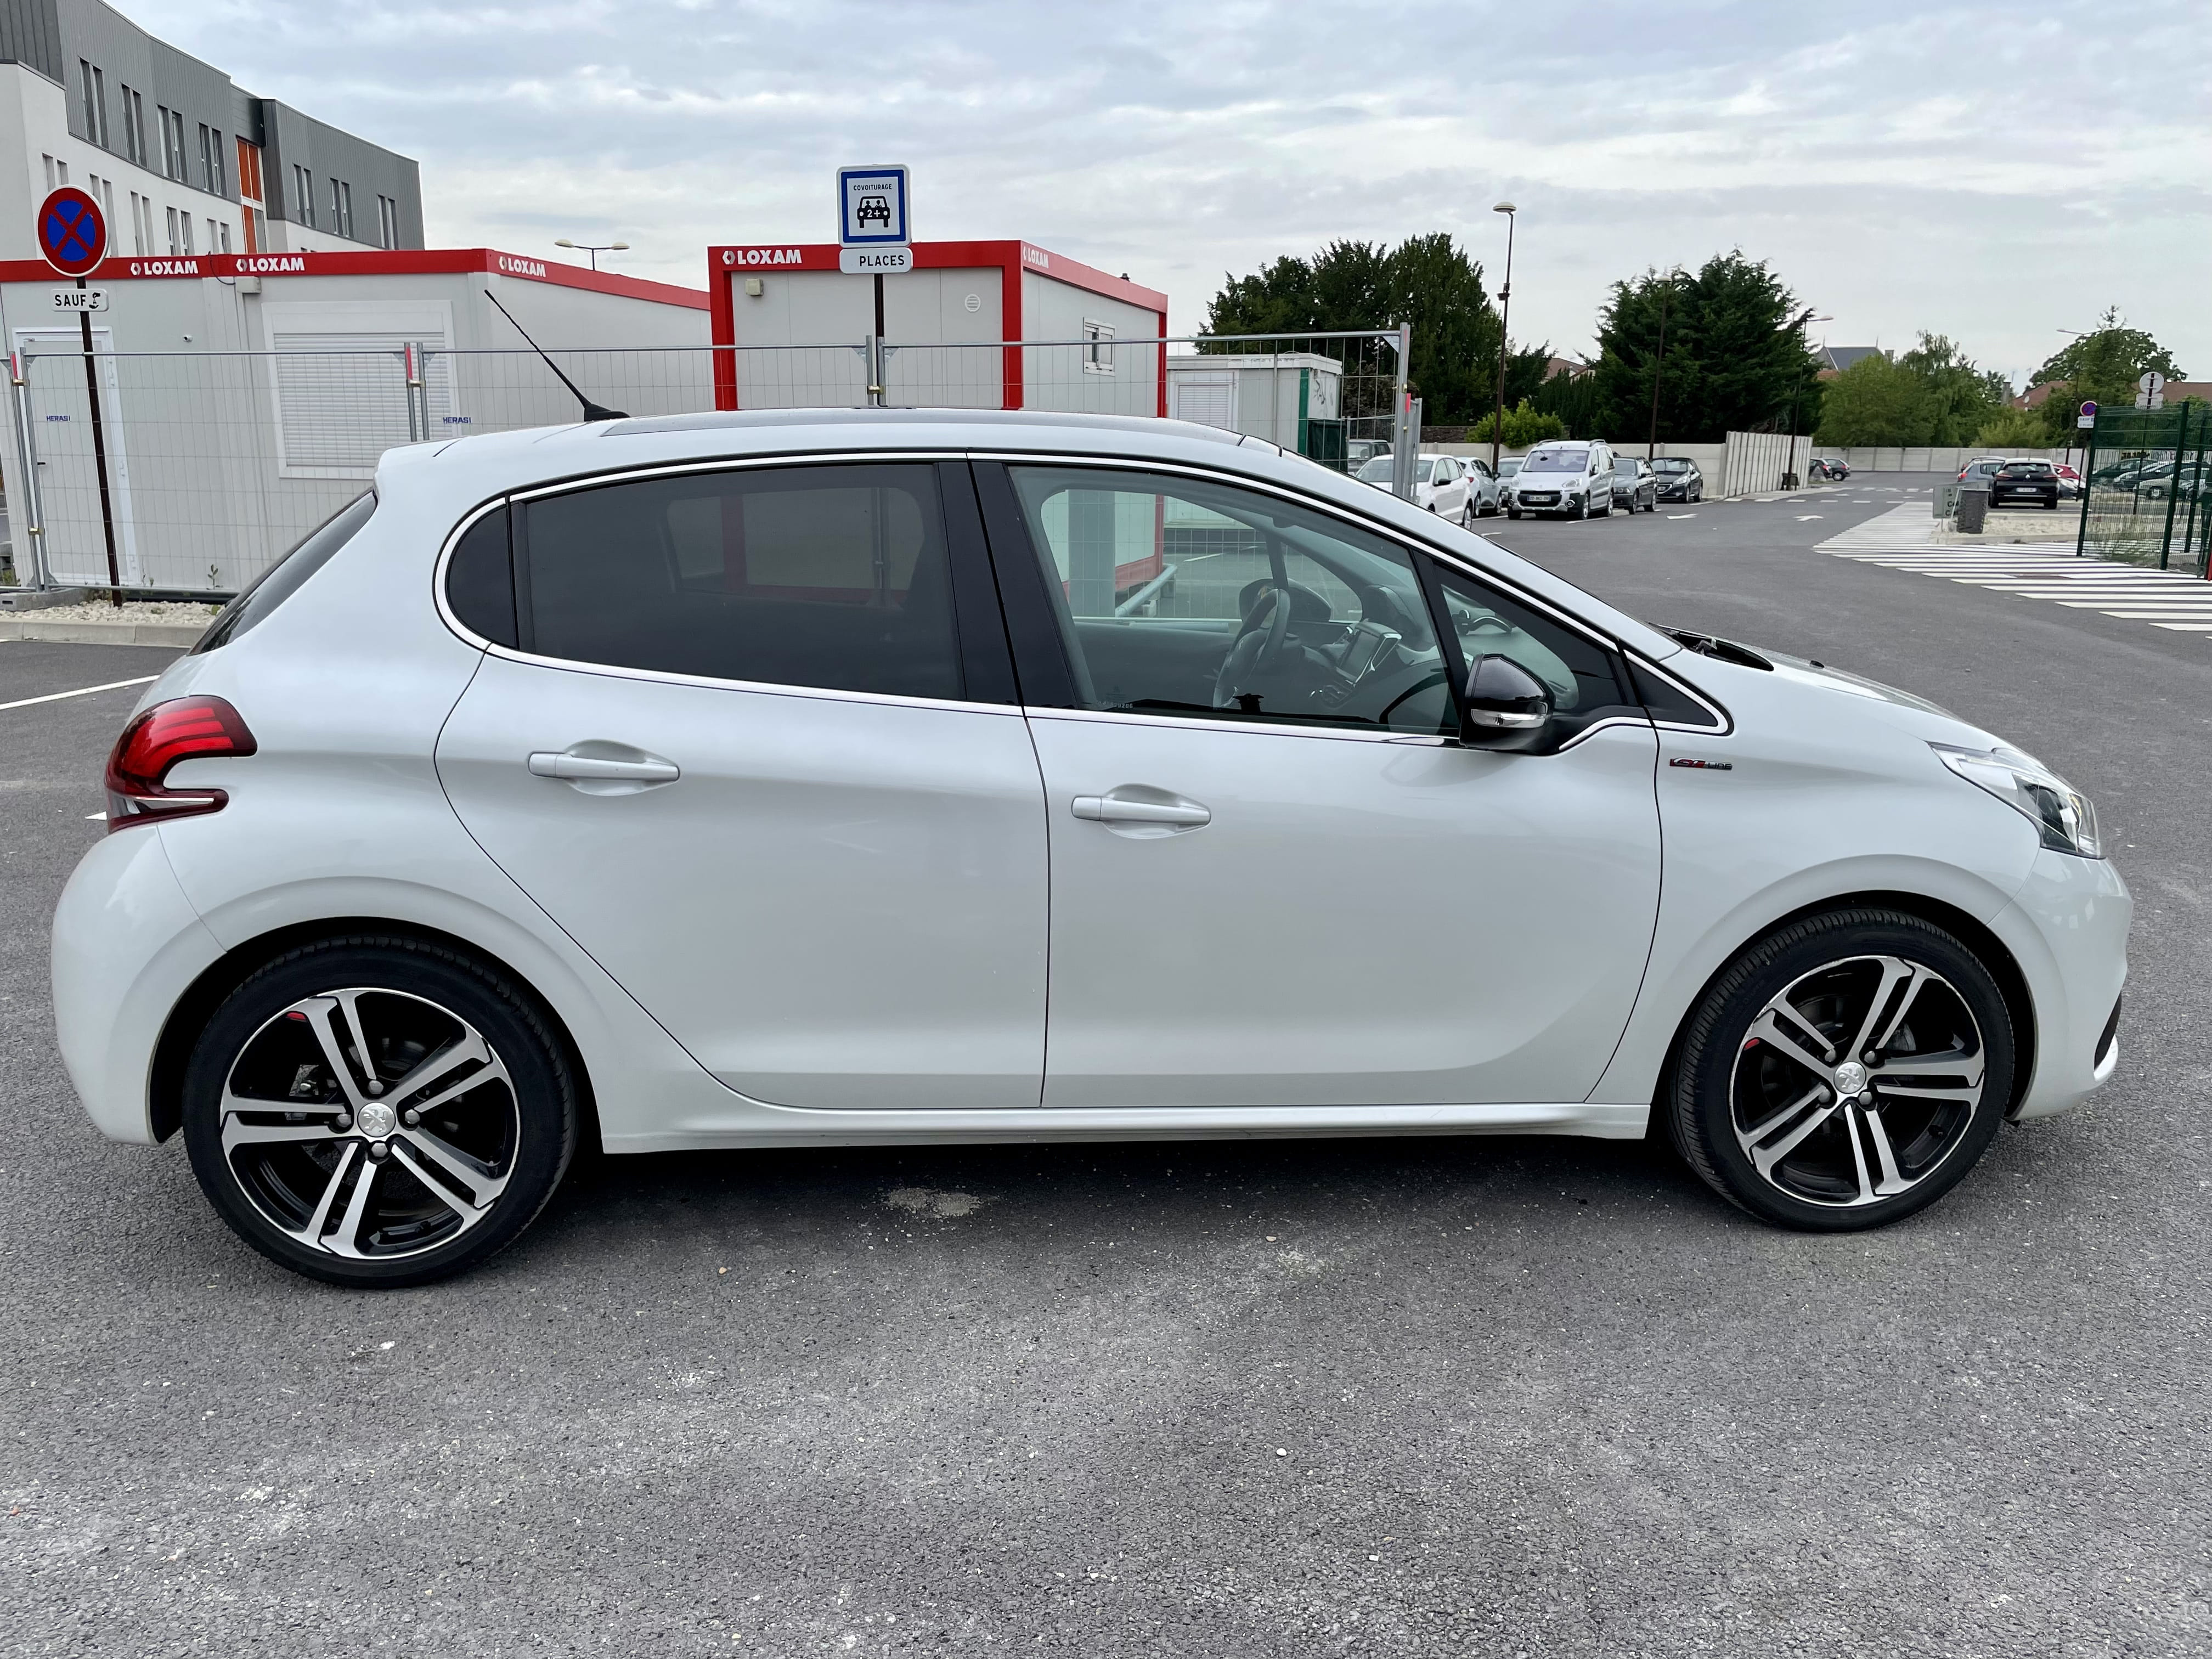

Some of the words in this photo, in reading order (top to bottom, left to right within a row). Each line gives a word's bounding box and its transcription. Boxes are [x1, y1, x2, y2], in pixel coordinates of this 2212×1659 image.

[867, 209, 881, 218] 2+
[737, 249, 802, 264] LOXAM
[860, 255, 905, 267] PLACES
[1028, 247, 1049, 269] LOXAM
[143, 261, 199, 275] LOXAM
[249, 257, 305, 272] LOXAM
[507, 257, 546, 278] LOXAM
[55, 294, 87, 306] SAUF
